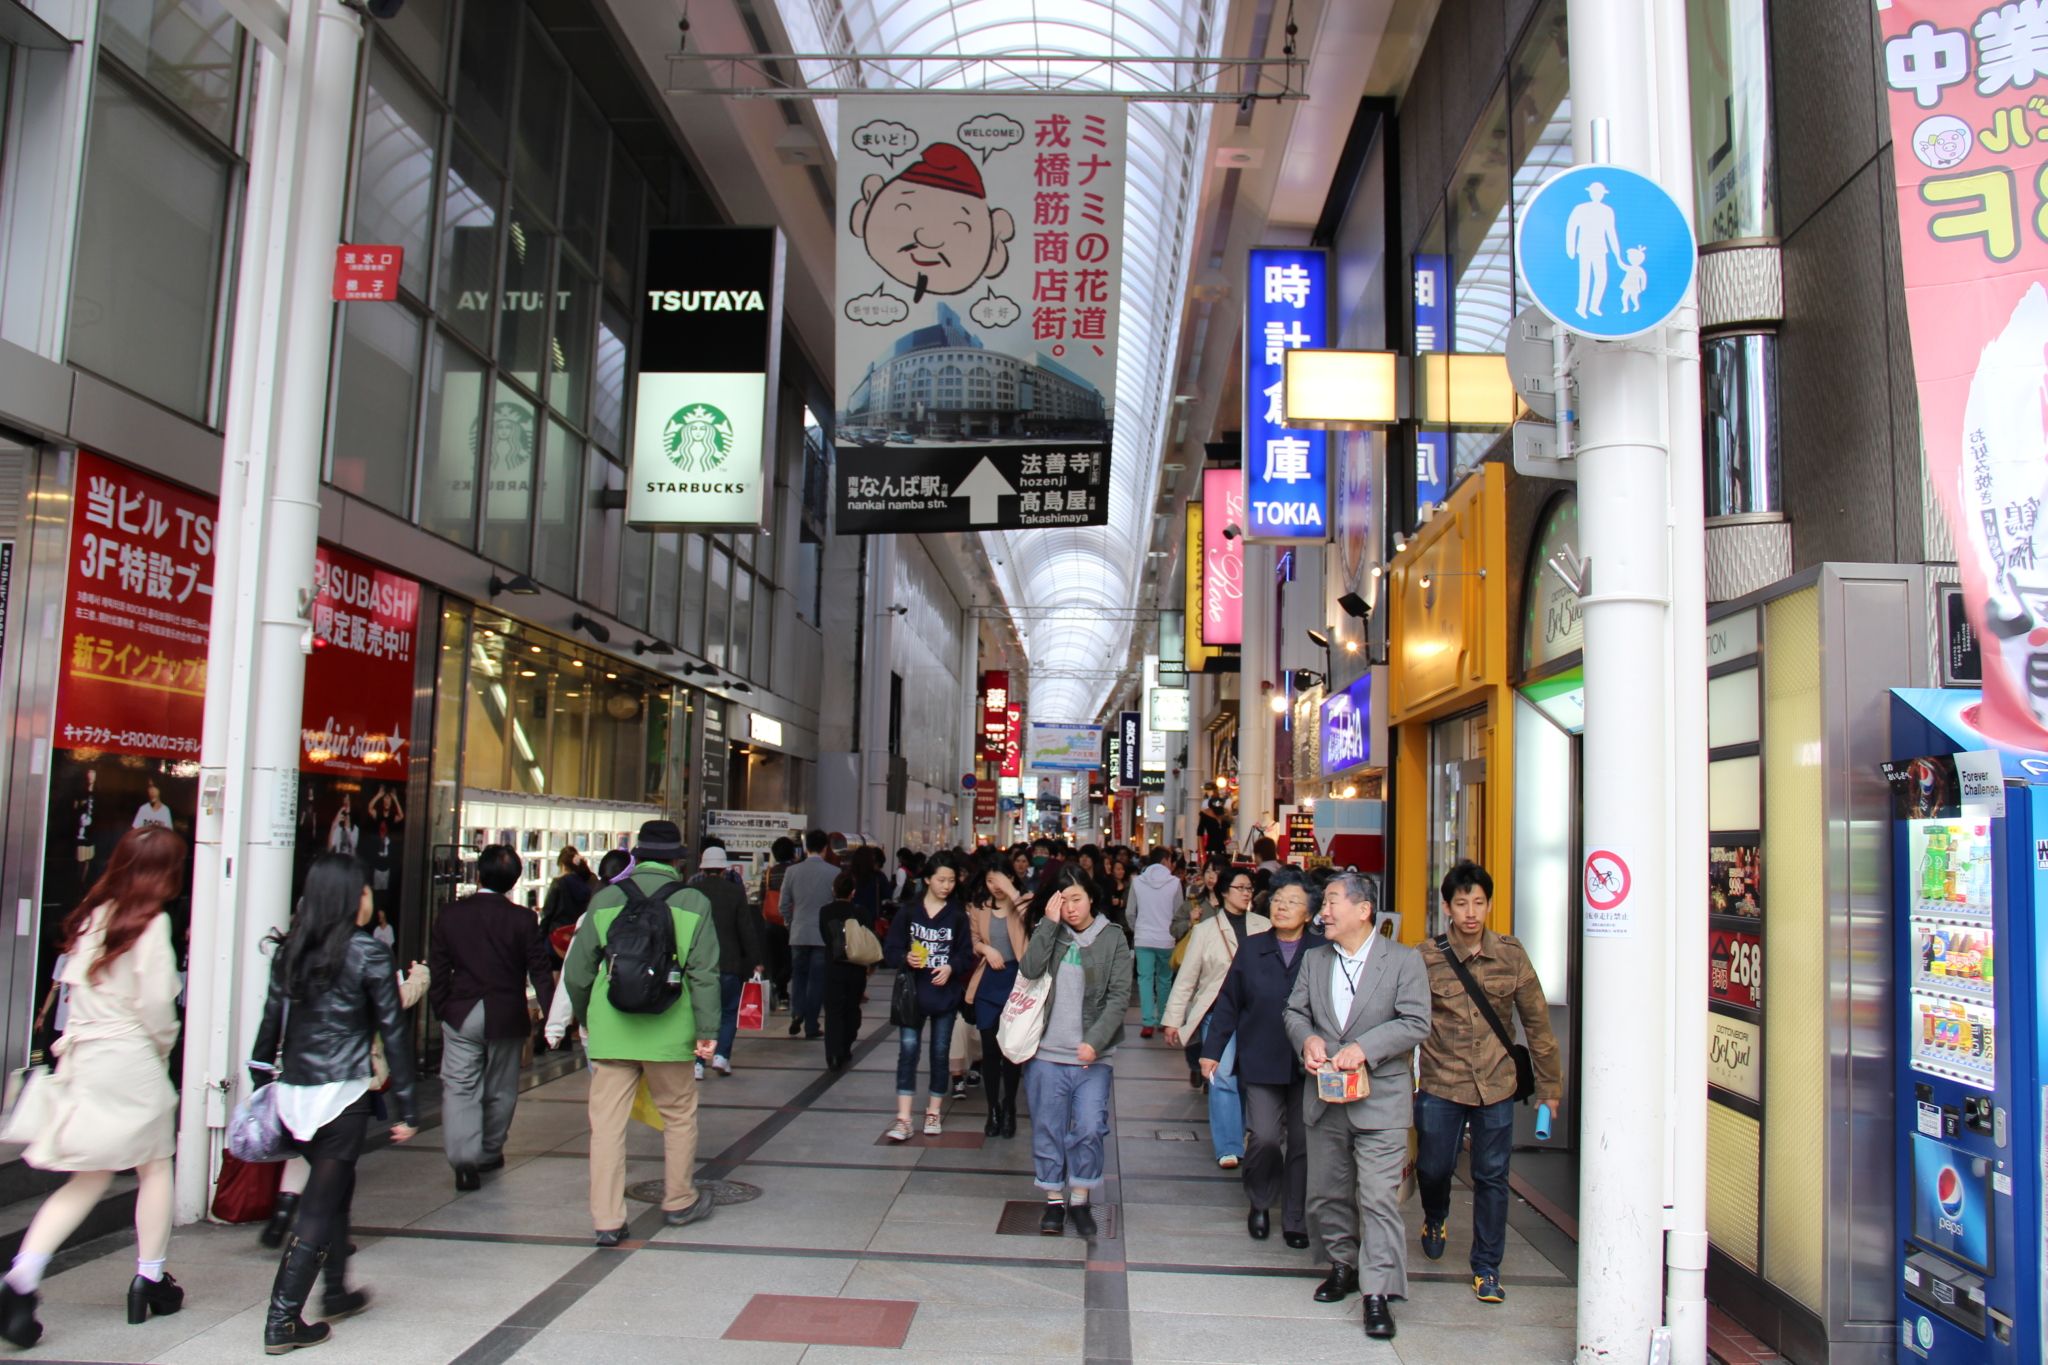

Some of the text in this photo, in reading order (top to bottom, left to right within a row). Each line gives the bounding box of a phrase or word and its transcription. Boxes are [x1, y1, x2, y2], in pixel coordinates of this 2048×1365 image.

[862, 133, 907, 146] まいど!
[963, 128, 1020, 138] WELCOME!
[1032, 114, 1071, 357] 戎橋筋商店街。
[1071, 114, 1112, 357] ミナミの花道、
[648, 290, 764, 312] TSUTAYA
[1021, 452, 1091, 475] 法善寺
[646, 482, 745, 494] STARBUCKS
[1020, 475, 1067, 487] hozenji
[848, 500, 948, 510] nankai namba stn.
[1253, 501, 1321, 526] TOKIA
[85, 475, 214, 556] 当ビル TS
[1019, 513, 1089, 524] Takashimaya
[1962, 771, 1989, 782] Forever
[1964, 784, 2002, 797] Challenge.
[1730, 939, 1760, 987] 268
[1984, 1028, 1993, 1059] BOSS
[1939, 1216, 1964, 1236] pepsi
